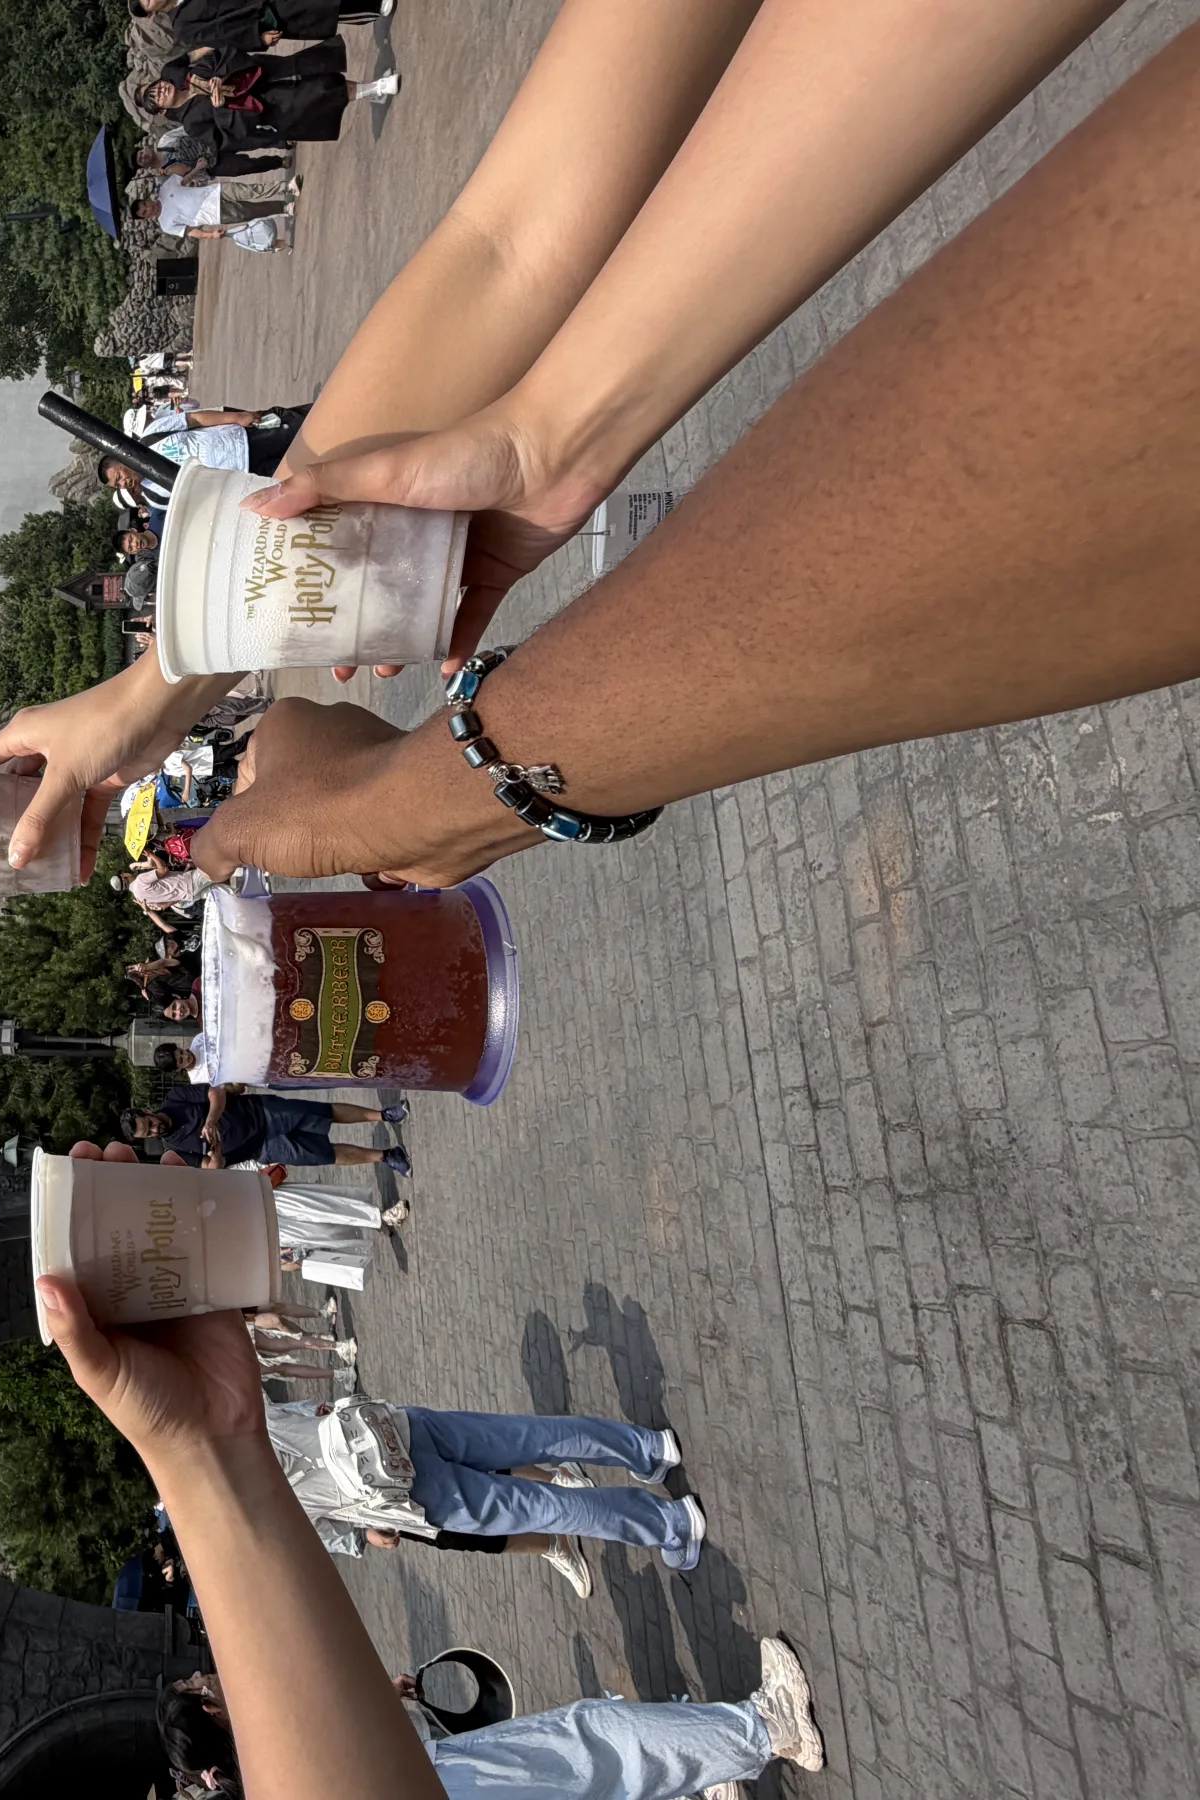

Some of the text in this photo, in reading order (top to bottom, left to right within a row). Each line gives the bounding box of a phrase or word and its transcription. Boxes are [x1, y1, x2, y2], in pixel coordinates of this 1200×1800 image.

[663, 491, 675, 515] MINIS
[265, 523, 288, 585] WORLD
[246, 604, 255, 620] THE
[288, 553, 337, 628] Harry
[324, 939, 349, 1071] BUTTERBEER
[107, 1230, 129, 1304] WIZARDING
[123, 1241, 142, 1291] WORLD
[147, 1266, 188, 1311] Harry
